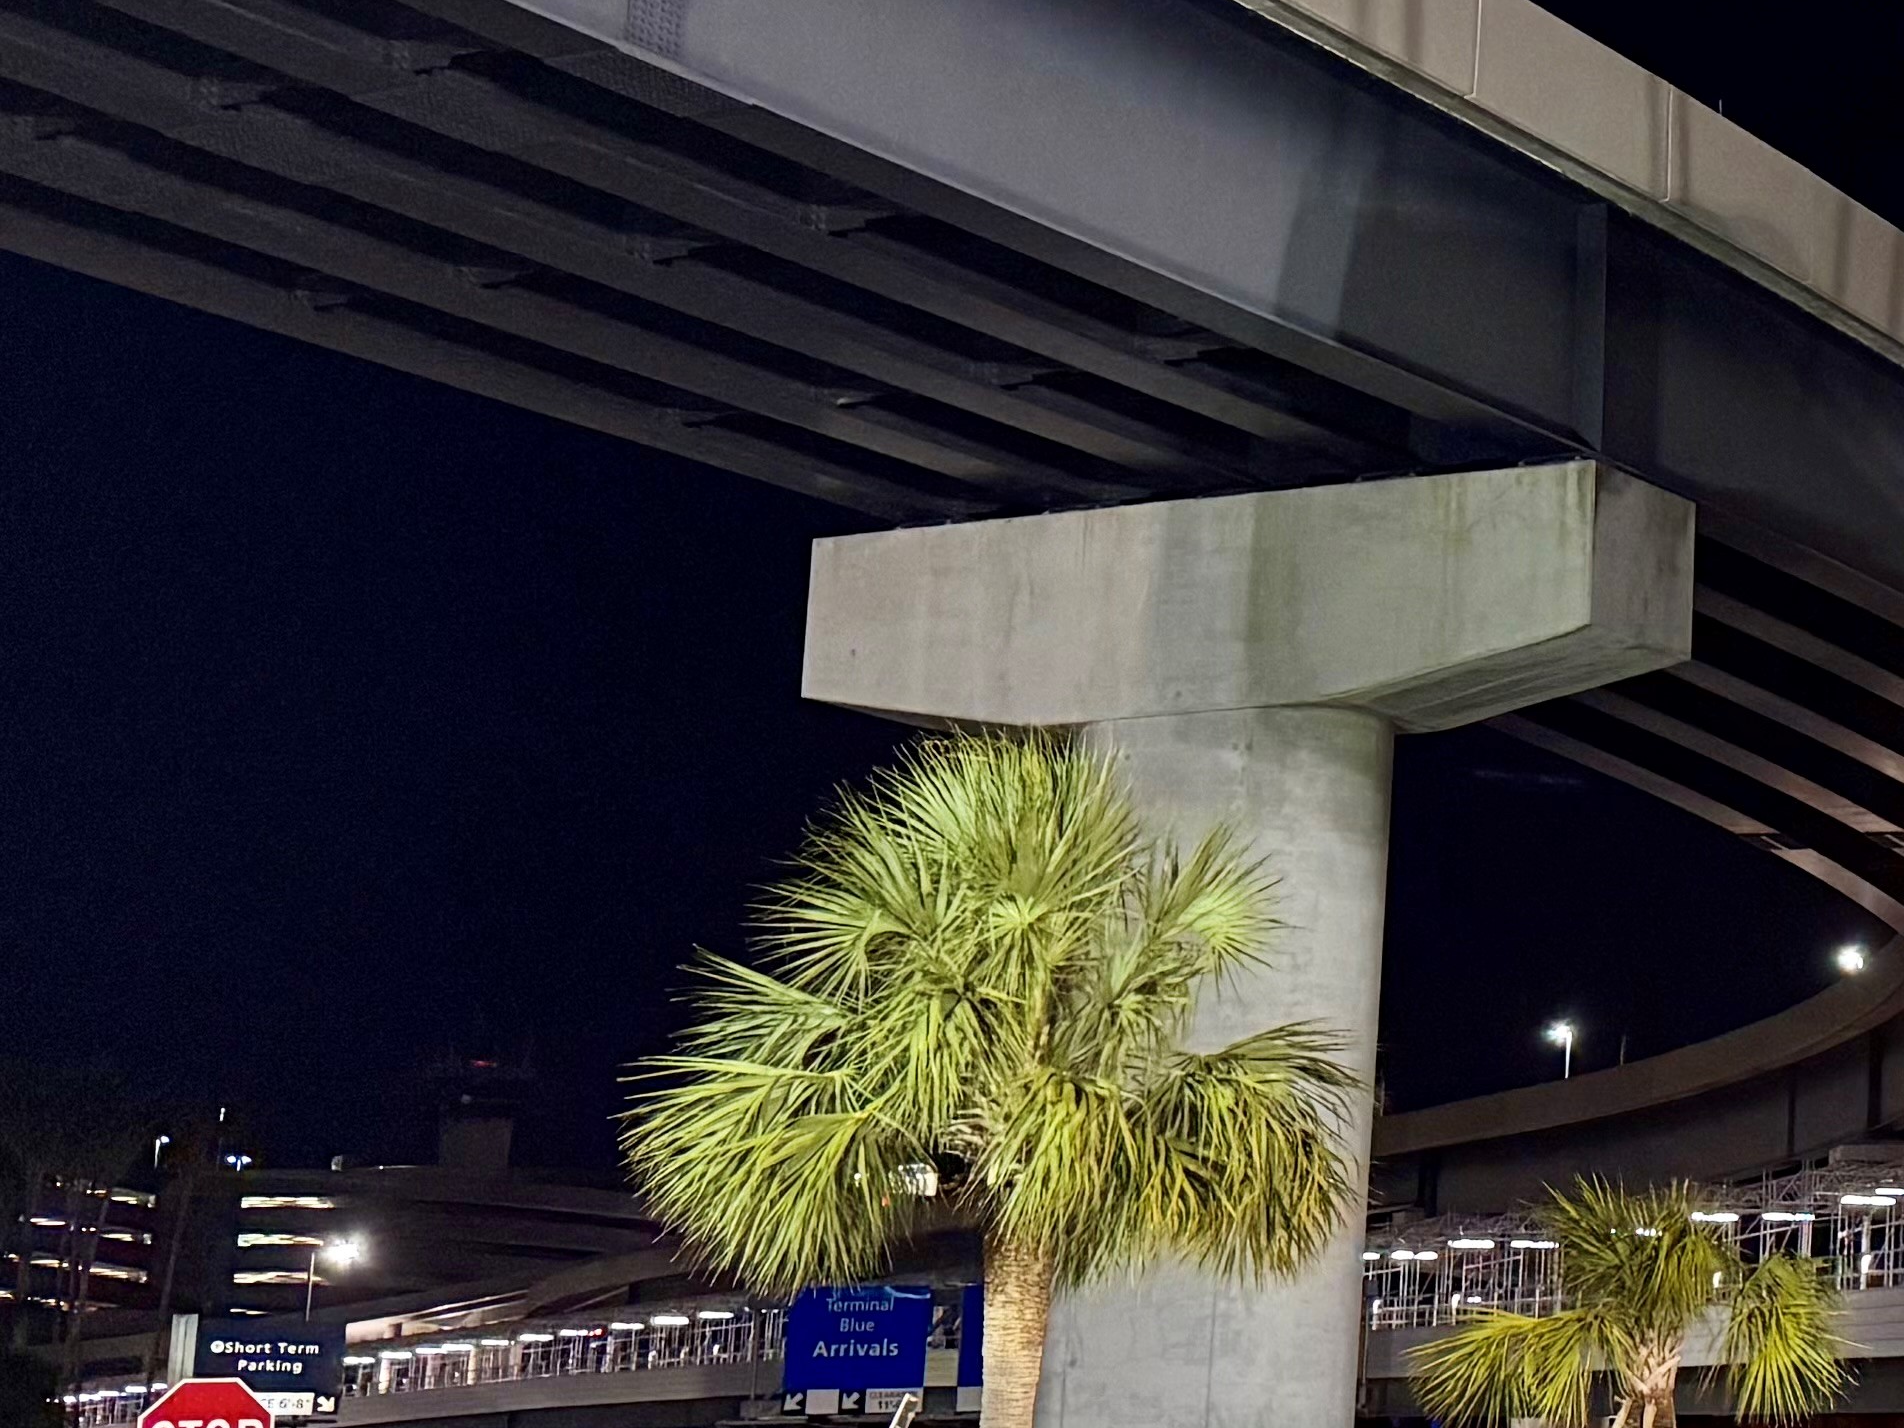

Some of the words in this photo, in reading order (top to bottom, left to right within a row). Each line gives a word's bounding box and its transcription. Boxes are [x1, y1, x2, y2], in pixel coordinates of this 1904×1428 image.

[826, 1296, 895, 1313] Terminal
[840, 1318, 875, 1332] Blue
[224, 1341, 272, 1355] Short
[278, 1342, 320, 1355] Term
[813, 1338, 899, 1357] Arrivals
[237, 1359, 303, 1375] Parking
